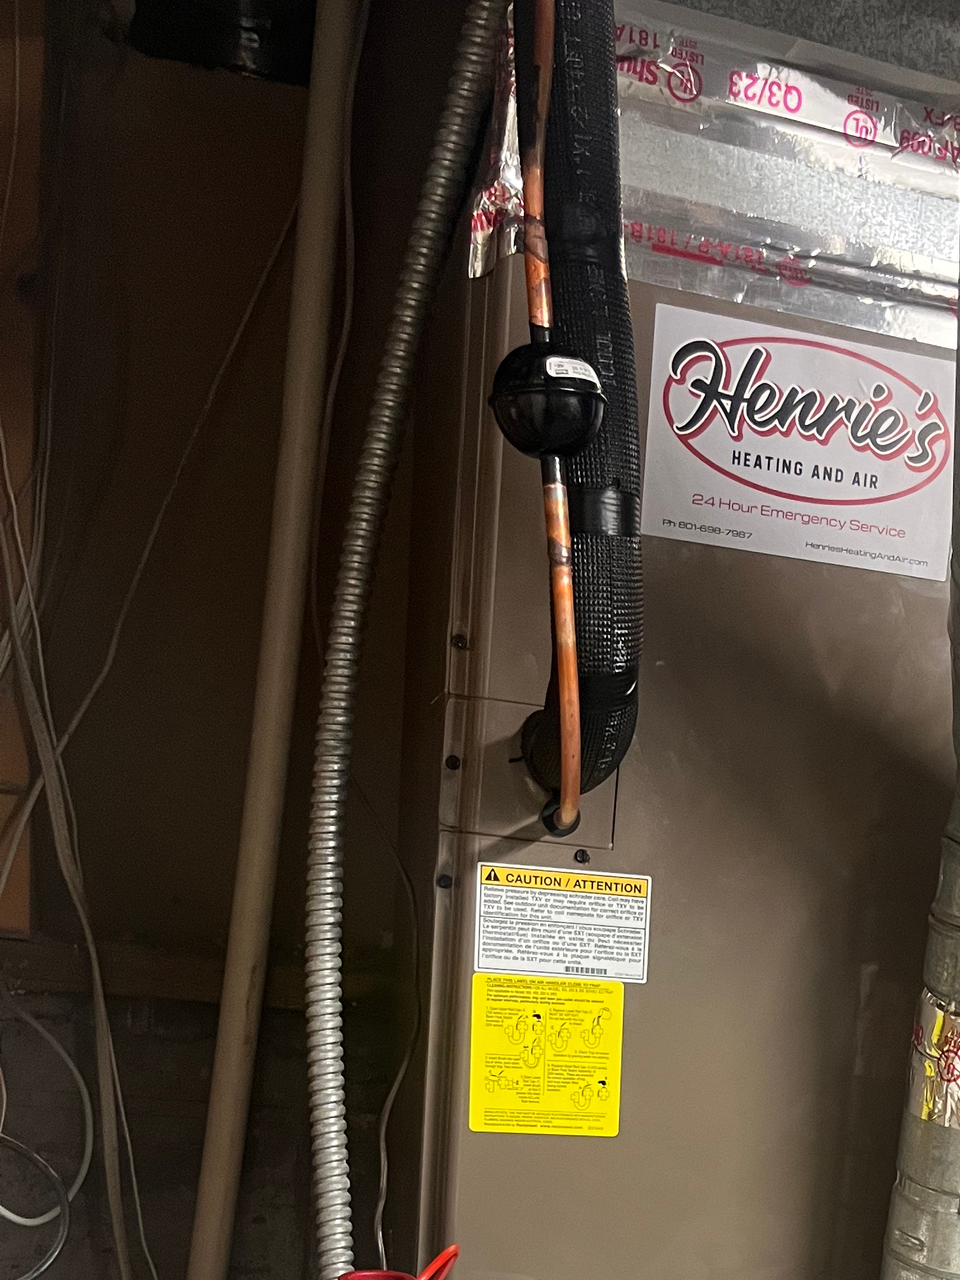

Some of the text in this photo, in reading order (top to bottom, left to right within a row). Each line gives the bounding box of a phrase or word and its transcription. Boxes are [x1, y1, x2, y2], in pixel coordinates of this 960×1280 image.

[728, 71, 803, 115] Q3/23
[847, 94, 879, 112] LISTED
[671, 339, 946, 470] Henrie's
[731, 449, 879, 490] HEATING AND AIR
[678, 521, 752, 540] 801-698-7987
[692, 494, 906, 539] 24 Hour Emergency Service
[805, 541, 928, 567] HenriesHeatingAndAir.com
[506, 874, 642, 893] CAUTION / ATTENTION
